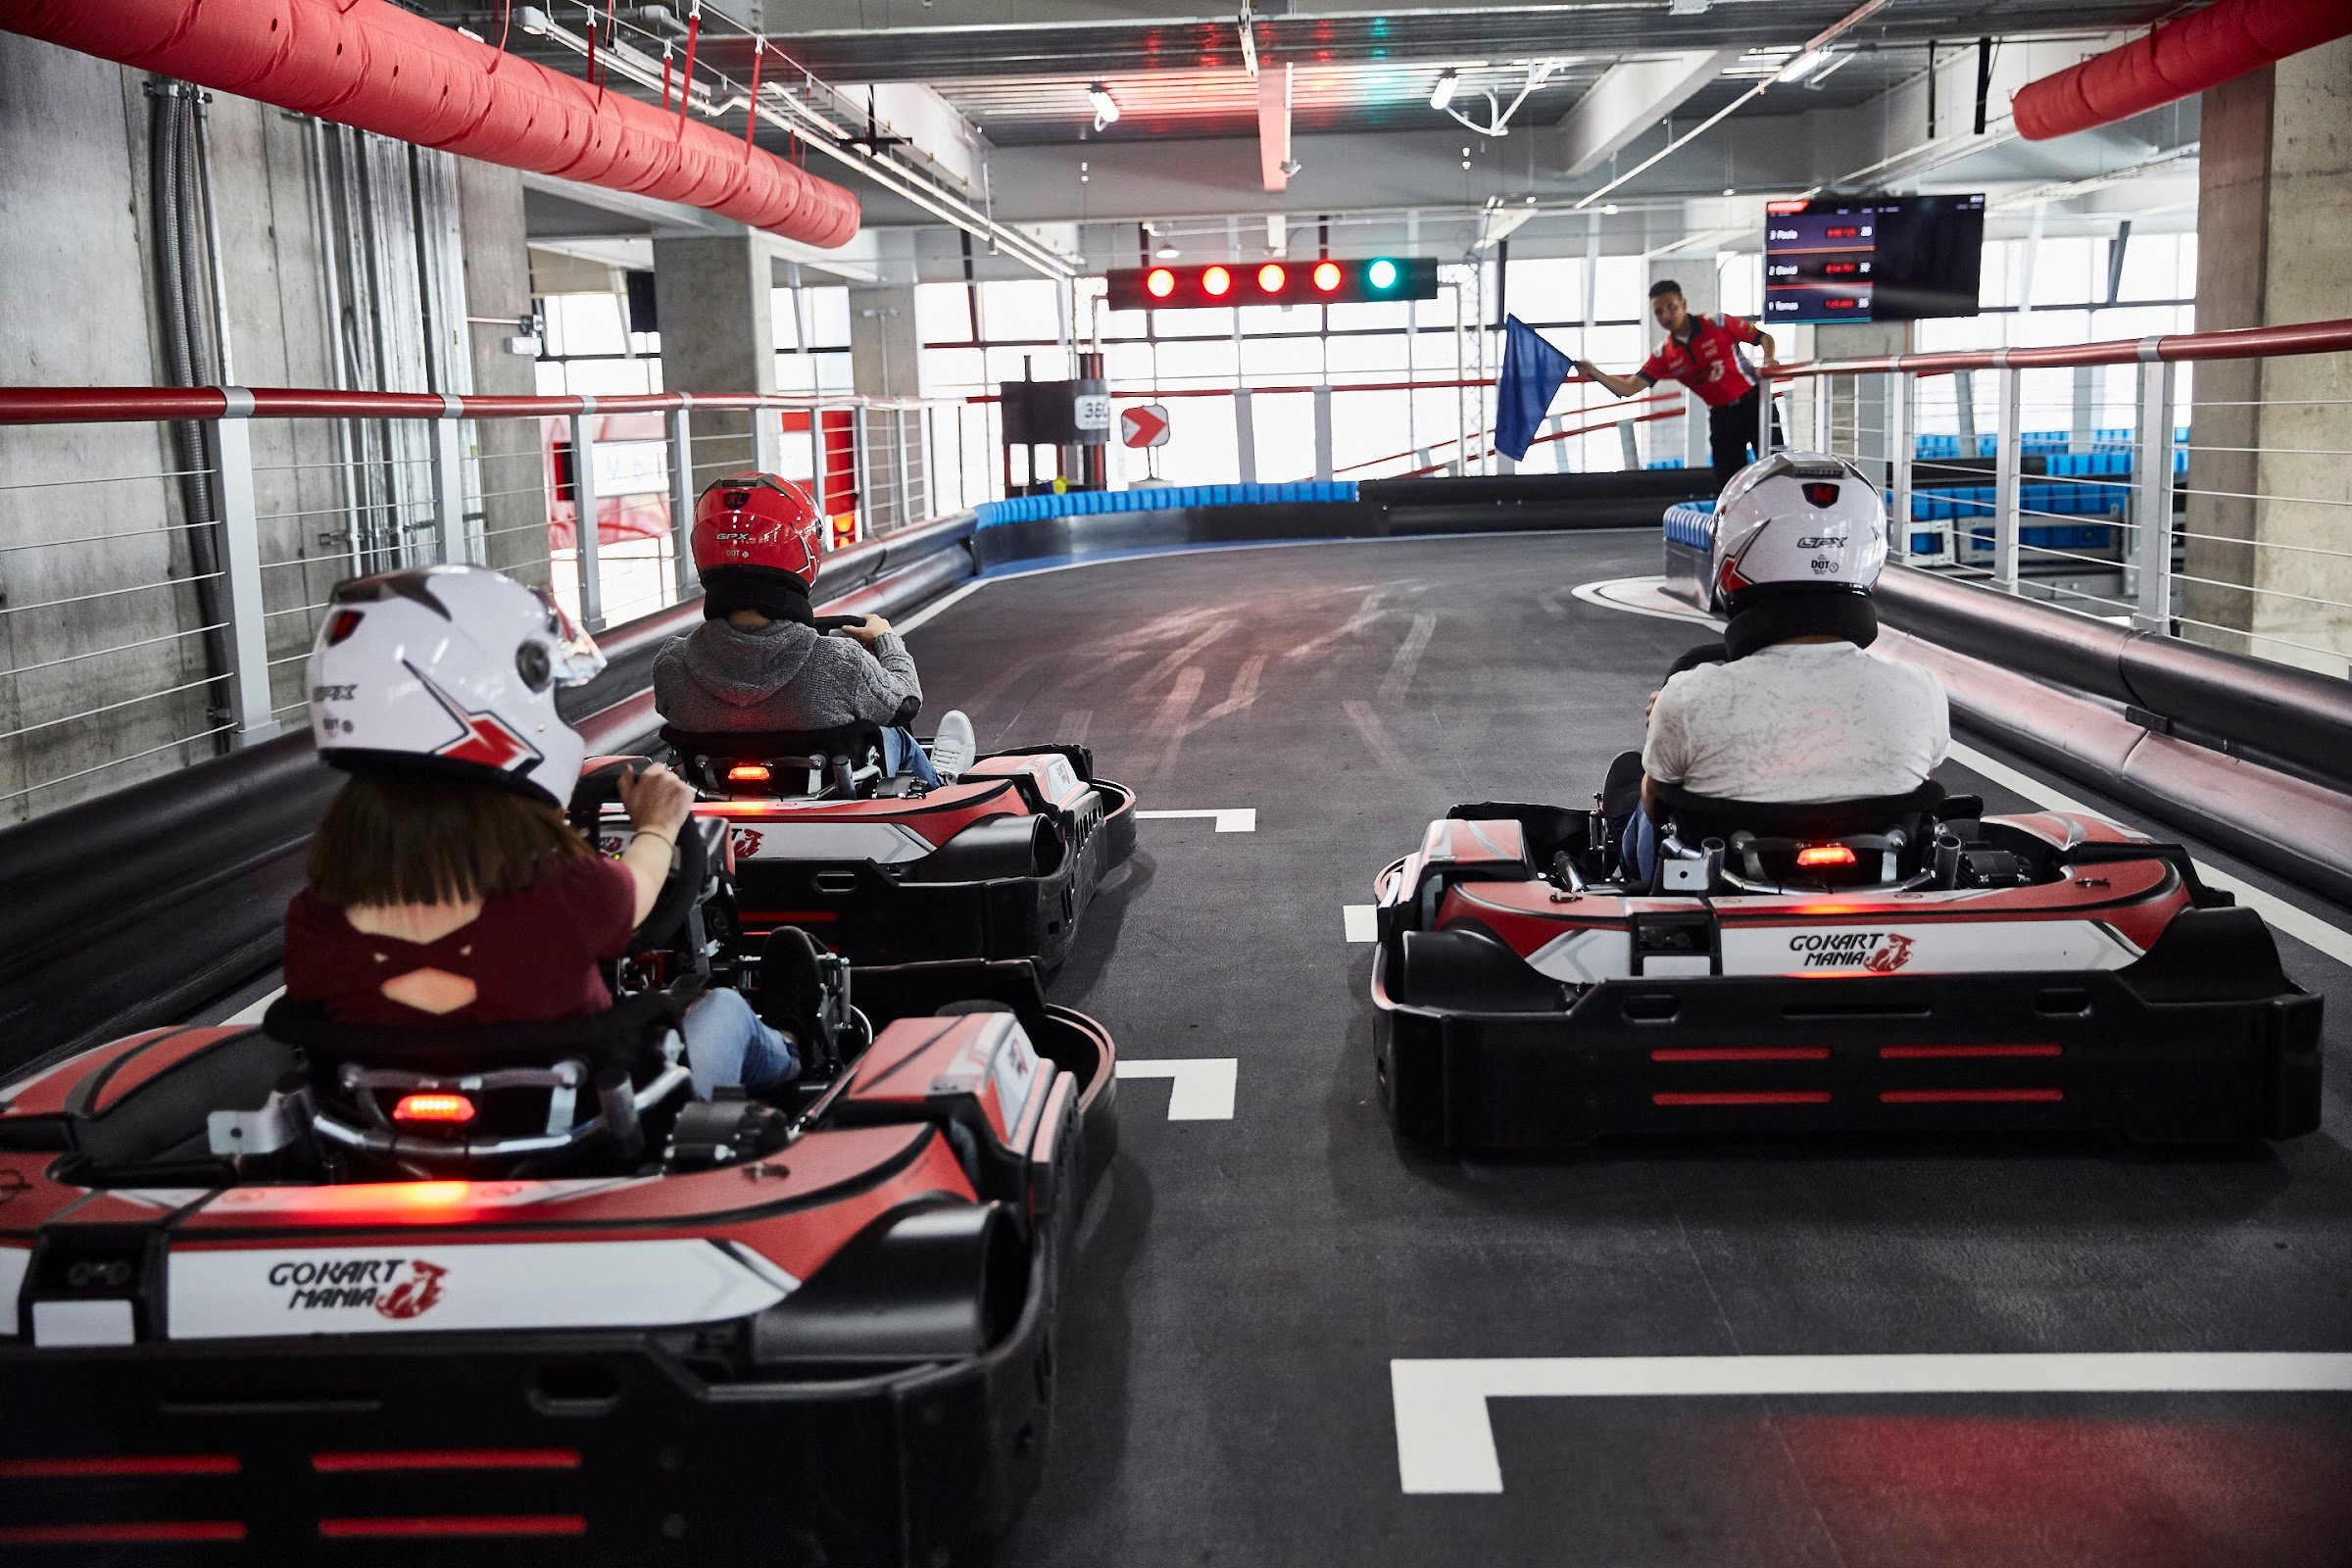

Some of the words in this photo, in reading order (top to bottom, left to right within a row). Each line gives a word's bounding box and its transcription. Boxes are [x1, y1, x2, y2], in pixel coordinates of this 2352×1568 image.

[715, 532, 750, 541] GPX
[1797, 537, 1847, 549] GPX
[1811, 560, 1830, 569] DOT
[1789, 933, 1884, 951] GOKART
[1804, 952, 1866, 966] MANIA
[269, 1259, 406, 1286] GOKART
[288, 1287, 377, 1309] MANIA
